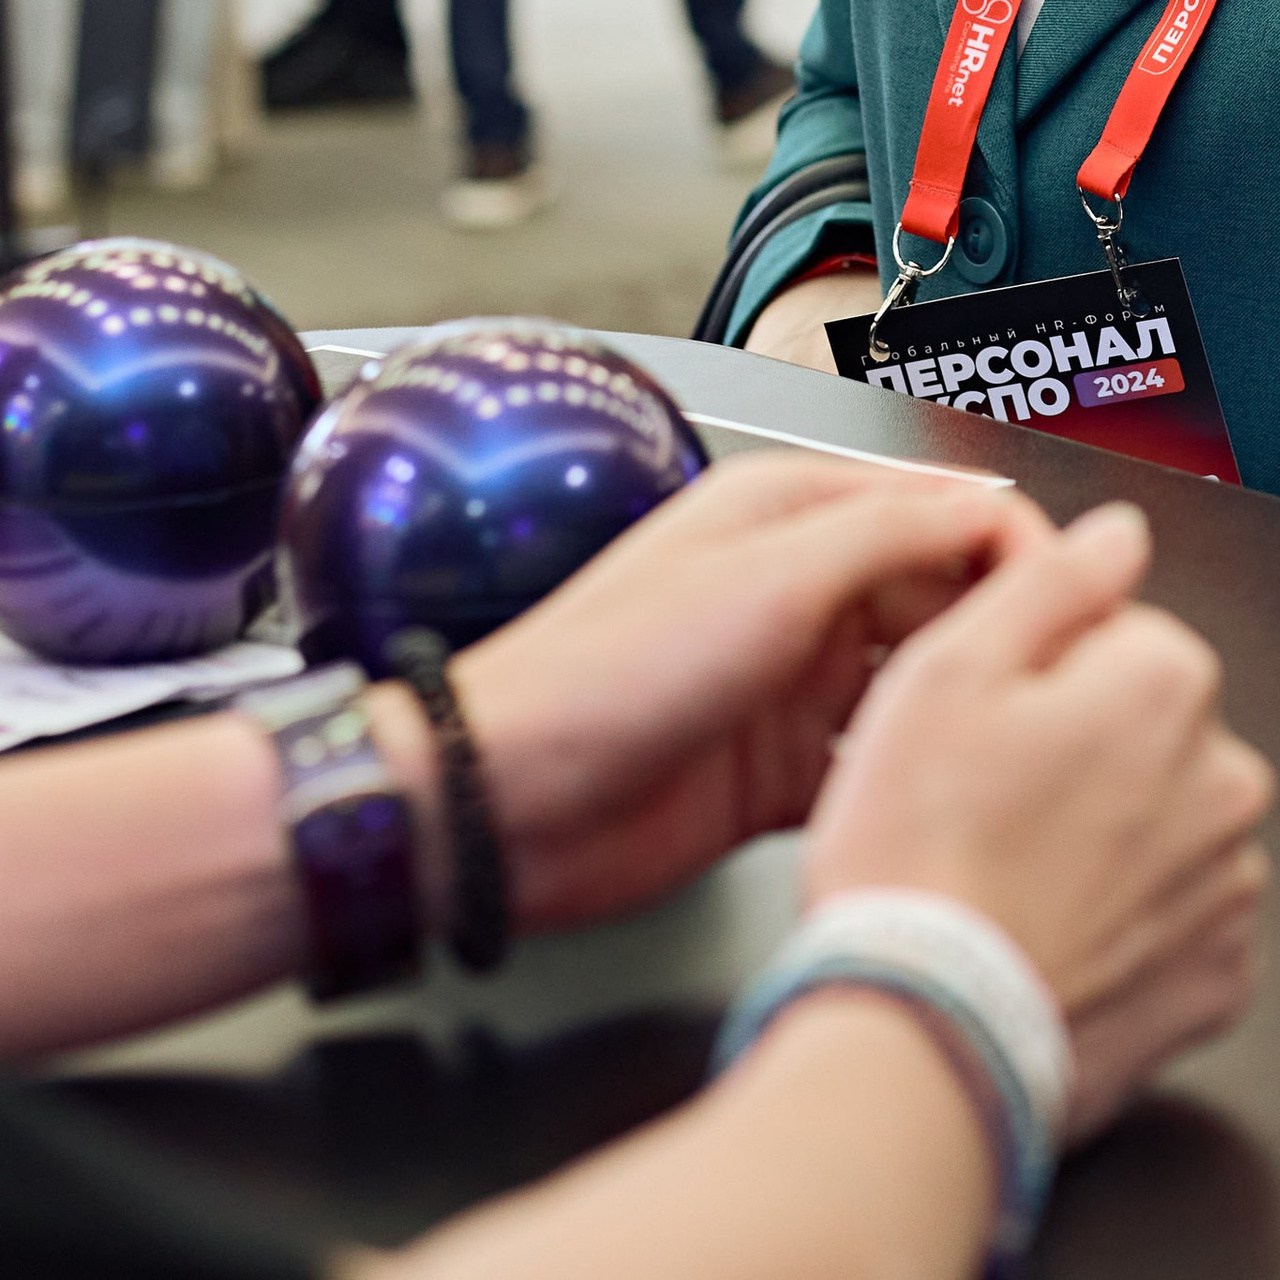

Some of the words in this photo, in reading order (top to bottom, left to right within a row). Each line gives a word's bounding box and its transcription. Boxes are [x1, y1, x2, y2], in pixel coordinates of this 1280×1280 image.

[947, 22, 996, 107] HRnet
[860, 327, 1018, 367] Гобальный
[1034, 303, 1166, 334] HR-Форм
[865, 316, 1177, 398] ПЕРСОНАЛ
[1093, 367, 1165, 398] 2024
